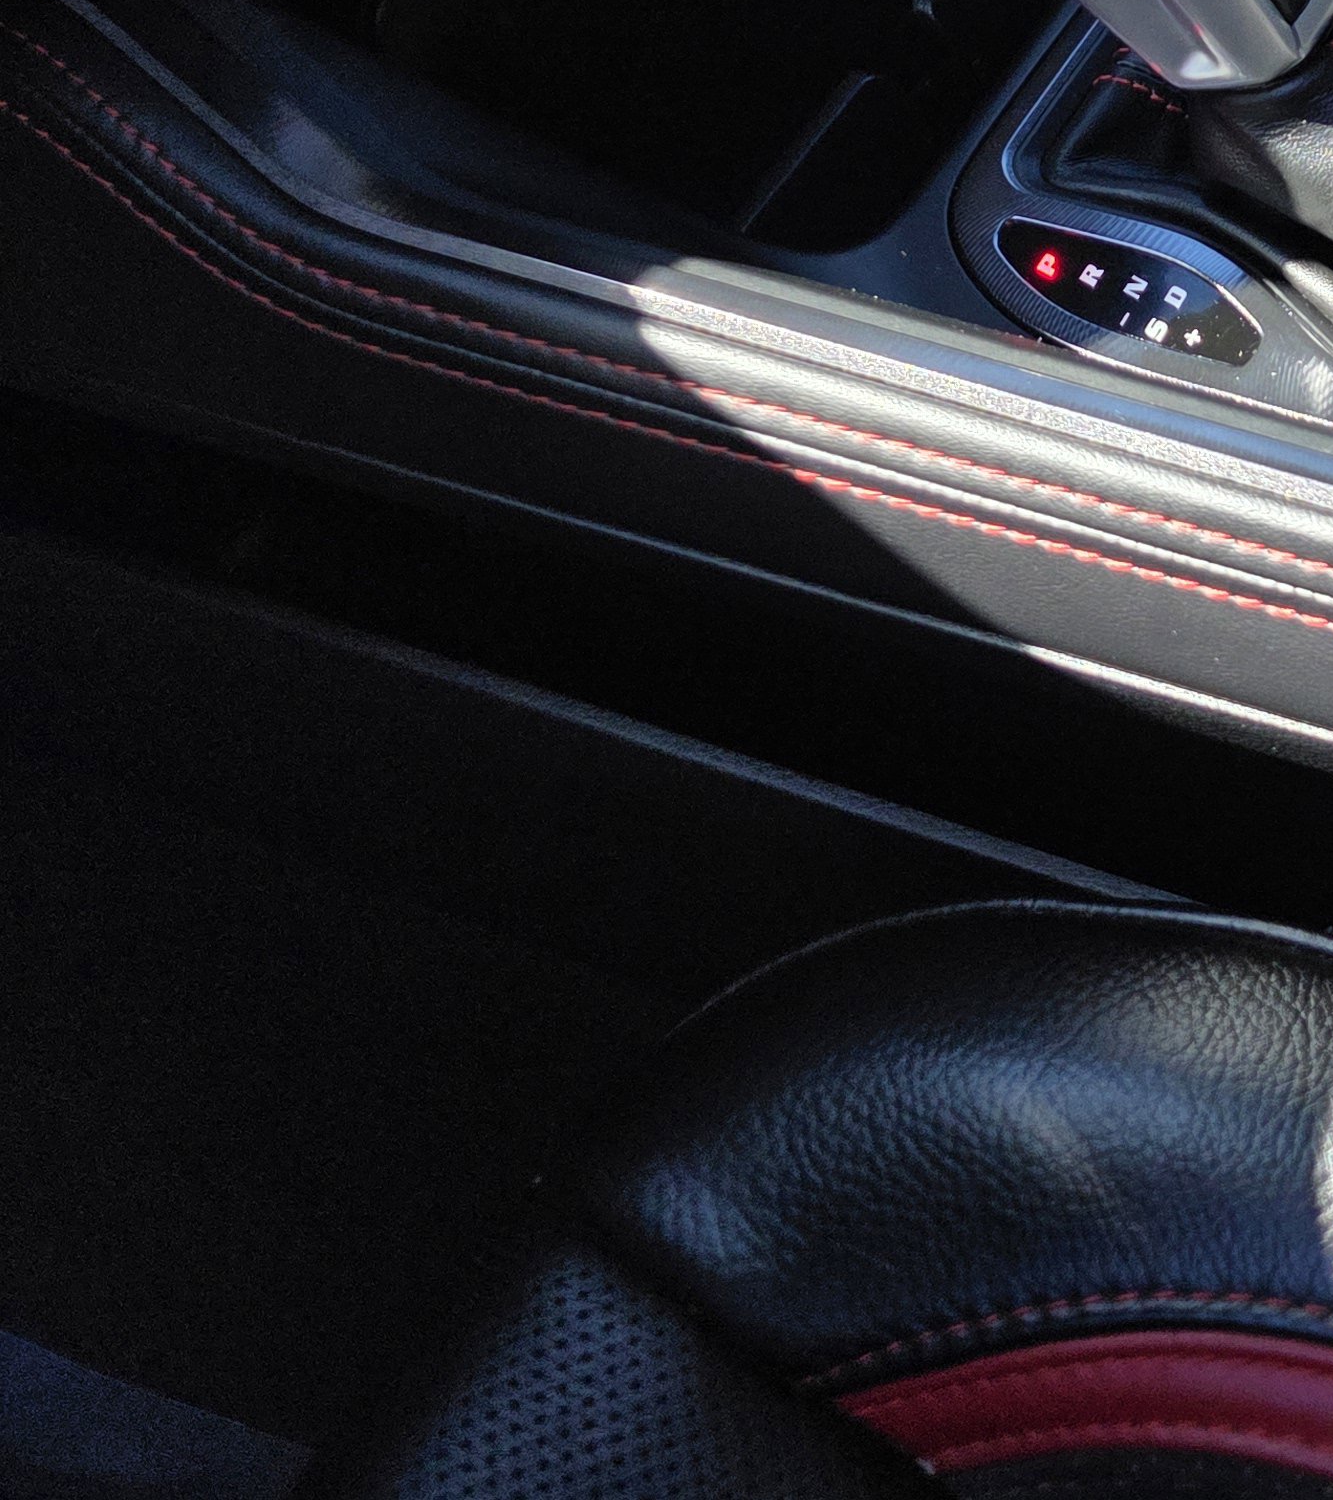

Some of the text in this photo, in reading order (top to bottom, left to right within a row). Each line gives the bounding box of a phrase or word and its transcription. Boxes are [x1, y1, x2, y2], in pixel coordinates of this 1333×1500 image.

[1036, 253, 1188, 310] P R N D
[1144, 317, 1169, 344] S
